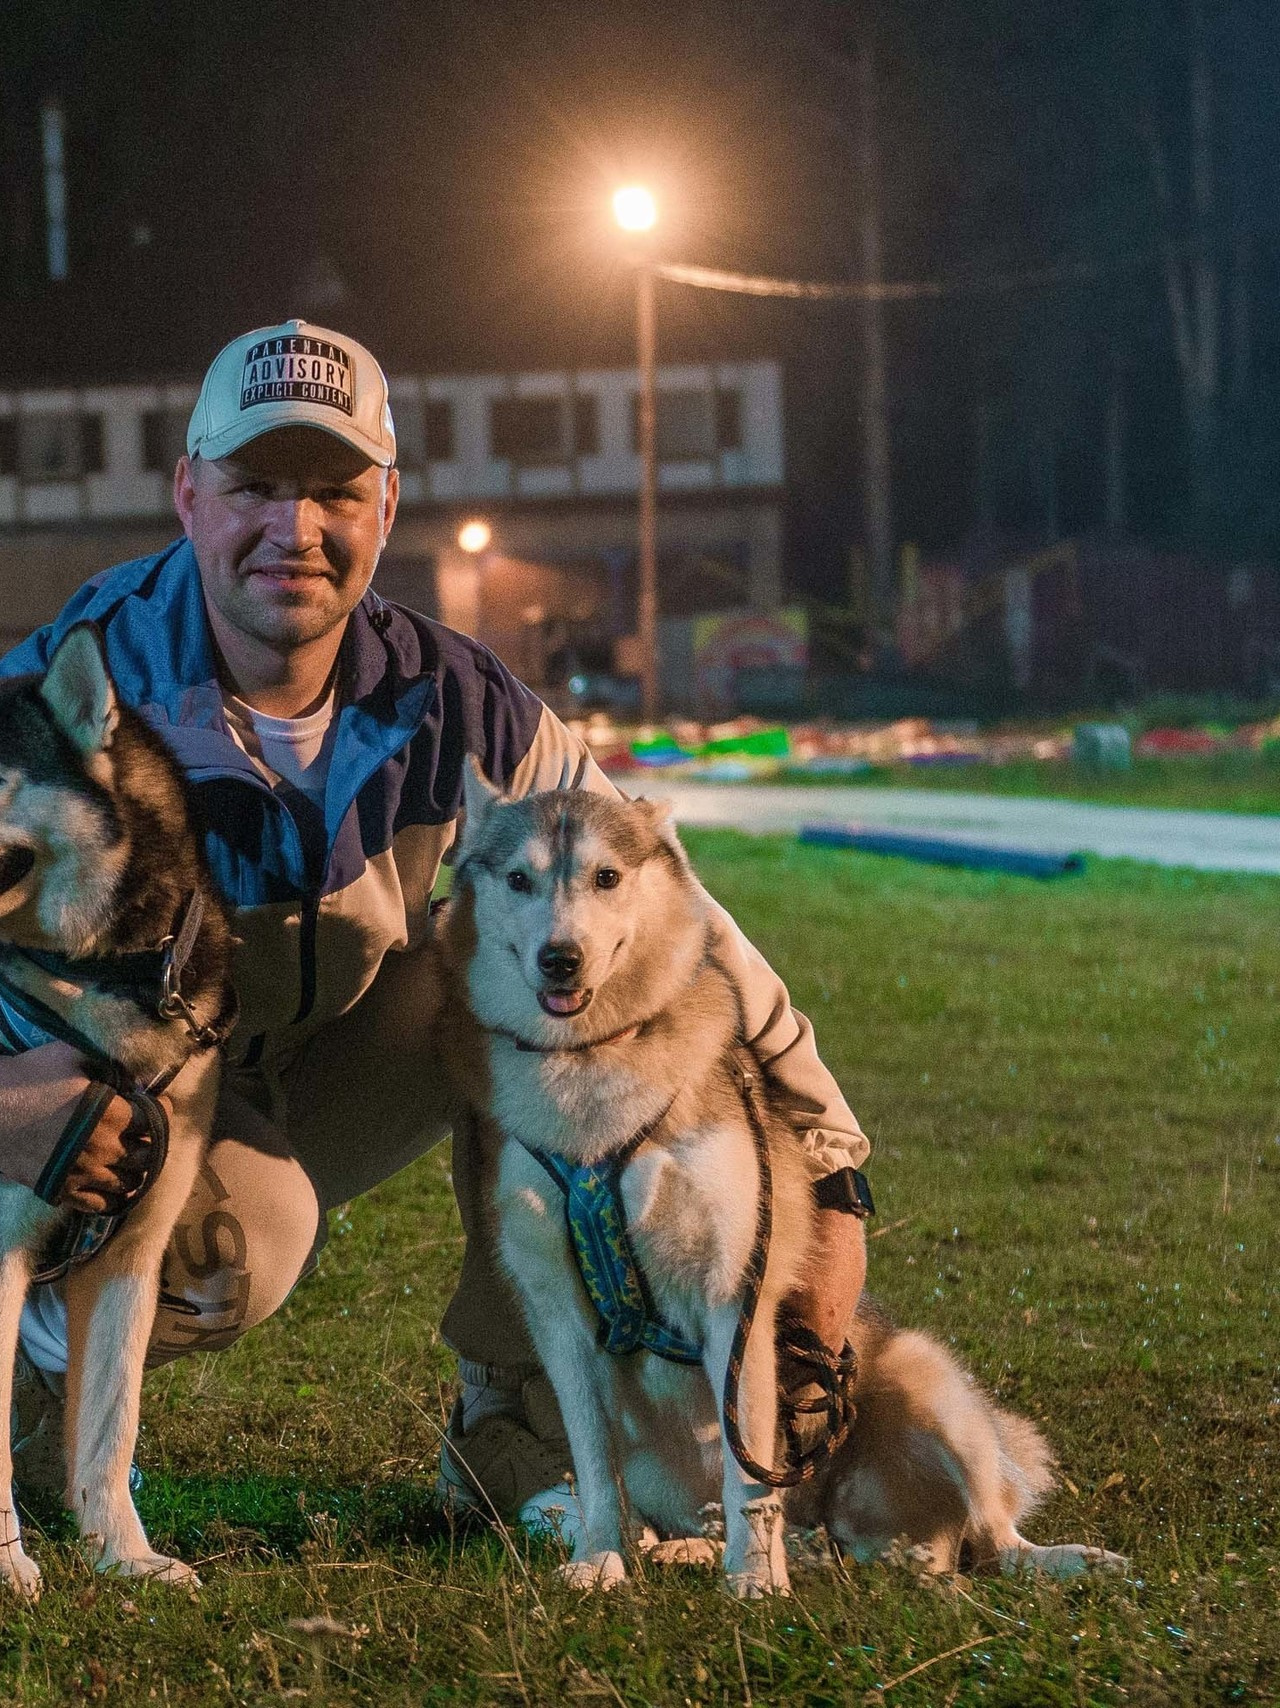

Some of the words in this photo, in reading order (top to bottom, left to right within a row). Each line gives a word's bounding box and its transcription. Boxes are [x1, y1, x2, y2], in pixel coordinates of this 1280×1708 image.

[251, 339, 345, 365] PARENTAL
[249, 357, 345, 388] ADVISORY
[245, 383, 295, 402] EXPLICIT
[302, 383, 349, 407] CONTENT
